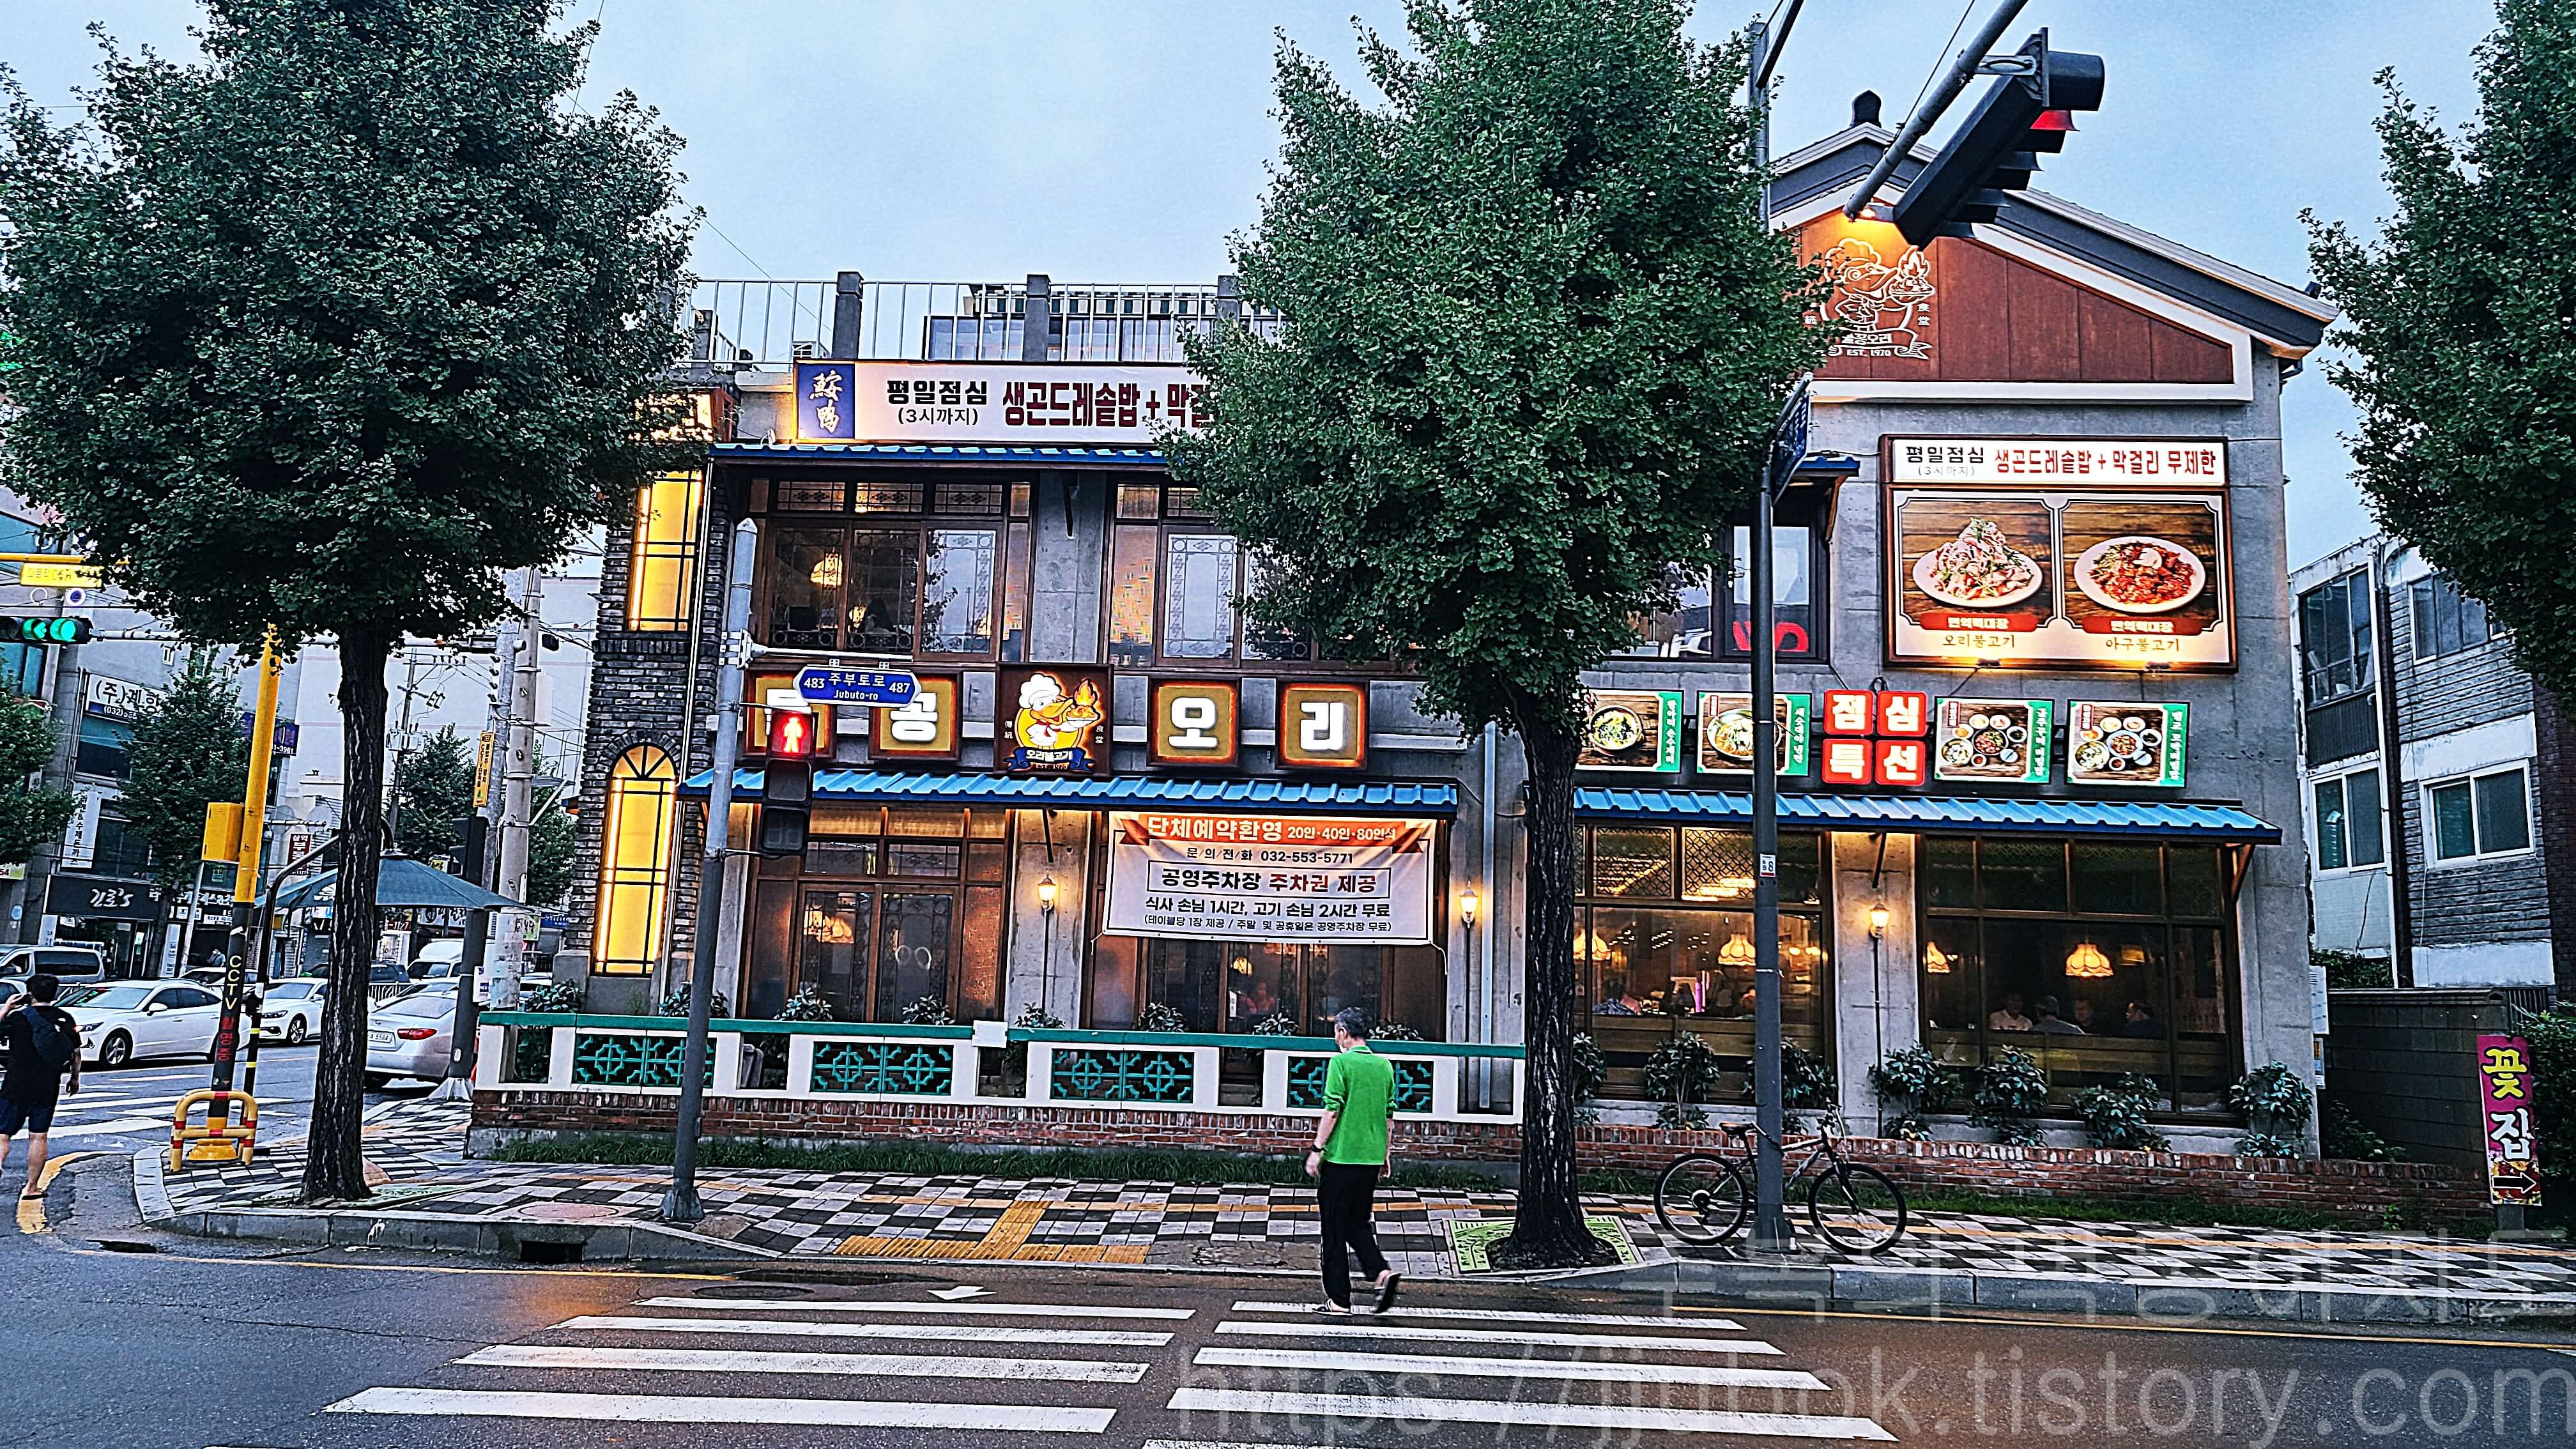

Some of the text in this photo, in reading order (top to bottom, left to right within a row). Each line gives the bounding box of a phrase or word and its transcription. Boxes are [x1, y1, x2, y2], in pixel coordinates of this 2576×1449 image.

[886, 379, 988, 406] 평일점심
[898, 408, 979, 426] (3시까지)
[1906, 446, 1984, 464] 평일점심
[2113, 450, 2159, 474] 막걸리
[2168, 449, 2216, 475] 무제한
[1918, 465, 1974, 476] (3시까지)
[1942, 635, 2015, 648] 오리불고기
[2105, 636, 2180, 652] 아구불고기
[804, 672, 910, 694] 483 주부토로 487
[834, 689, 878, 700] Jubuto-ro
[1832, 694, 1919, 732] 점심
[1025, 749, 1073, 762] 오리불고기
[1829, 744, 1917, 781] 특선
[1148, 816, 1283, 842] 단체예약환영
[1261, 850, 1353, 864] 032-553-5771
[1162, 868, 1376, 893] 공영주차장 주차권 제공
[1146, 896, 1390, 917] 식사 손님 1시간, 고기 손님 2시간 무료
[1144, 914, 1186, 926] (테이블당
[1189, 917, 1202, 927] 1장
[1206, 918, 1225, 928] 제공
[1237, 919, 1256, 930] 주말
[1262, 921, 1272, 930] 및
[1275, 921, 1314, 931] 공휴일은
[1317, 922, 1365, 931] 공영주차장
[1368, 922, 1392, 931] 무료)
[225, 955, 241, 1010] CCTV
[2482, 1048, 2530, 1160] 꽃집
